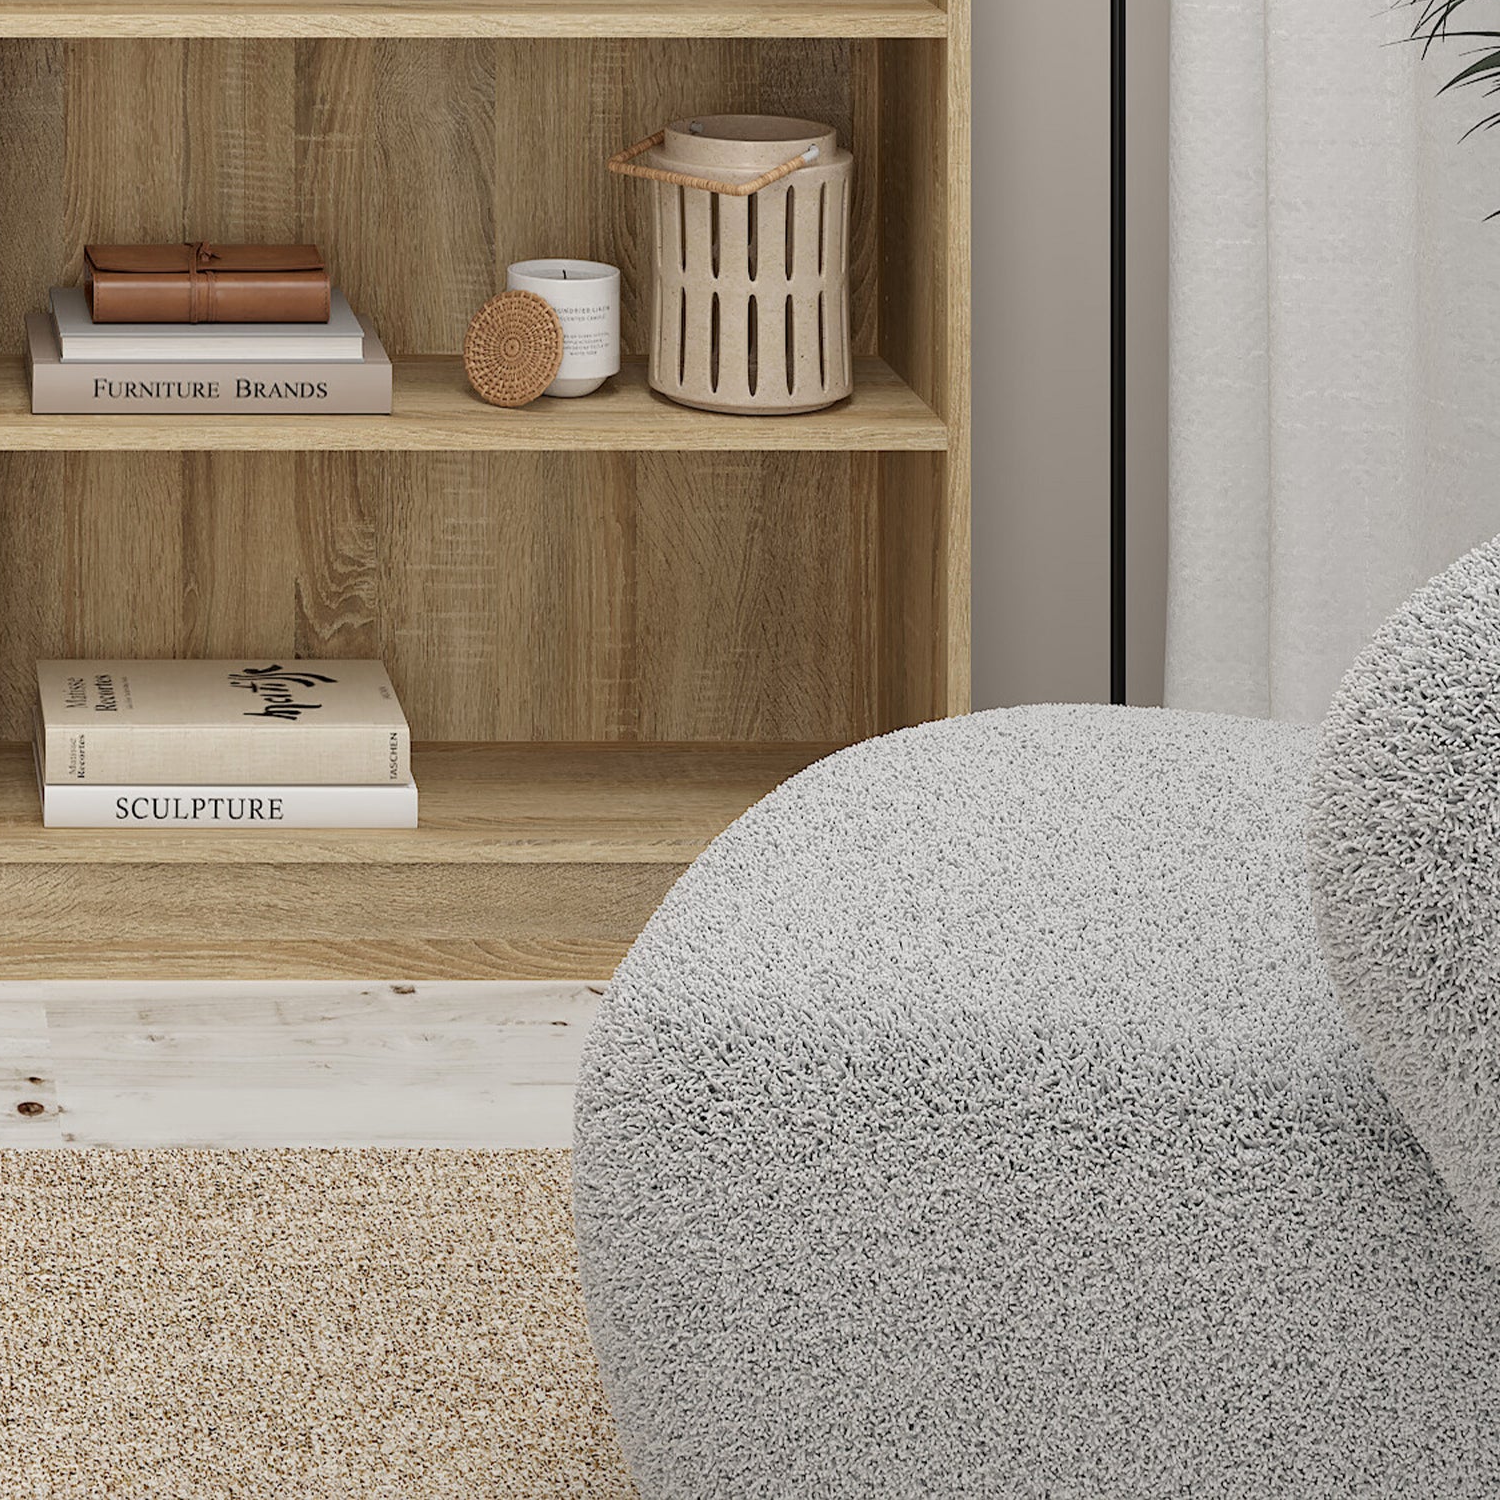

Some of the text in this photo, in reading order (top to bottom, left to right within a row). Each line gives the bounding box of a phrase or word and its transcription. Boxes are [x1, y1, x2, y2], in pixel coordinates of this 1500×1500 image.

[92, 378, 328, 399] FURNITURE BRANDS
[389, 731, 398, 781] TASCHEN
[115, 796, 285, 821] SCULPTURE
